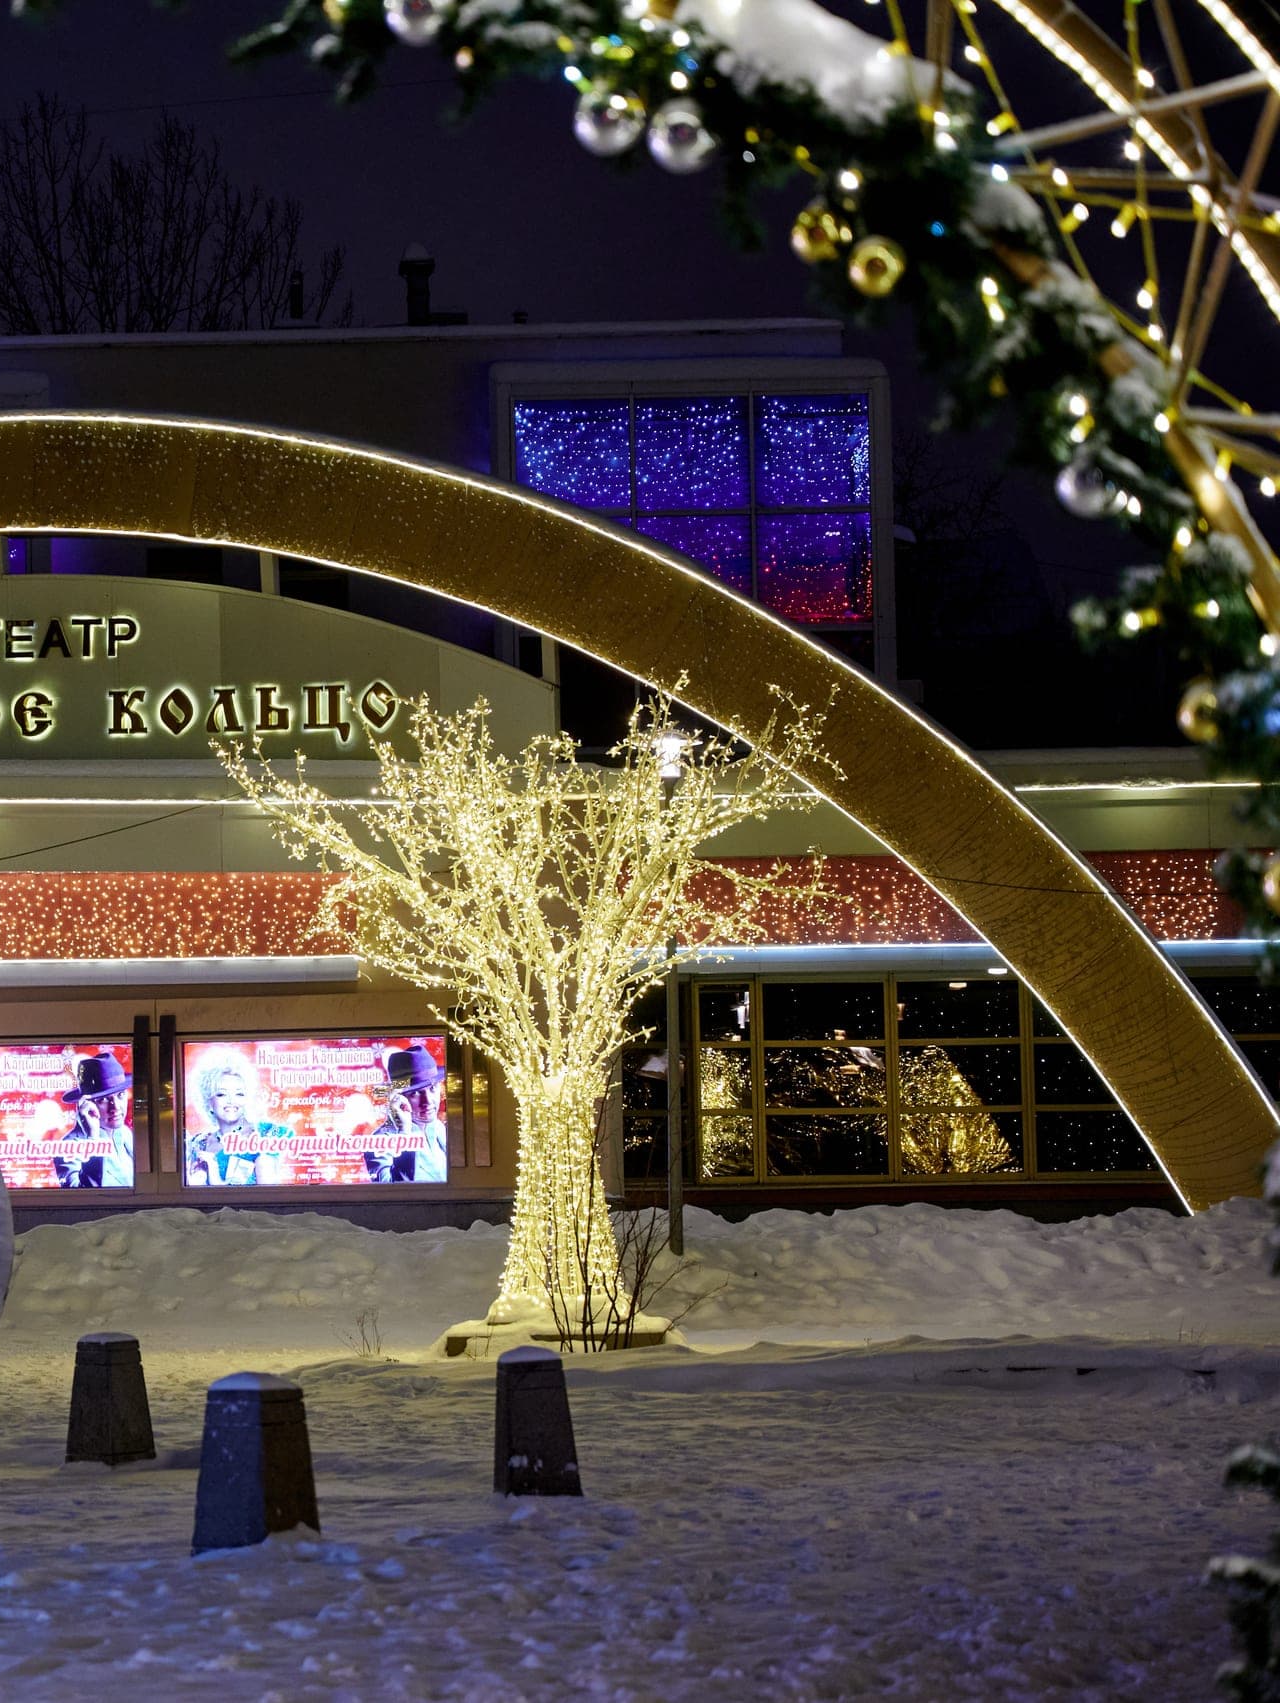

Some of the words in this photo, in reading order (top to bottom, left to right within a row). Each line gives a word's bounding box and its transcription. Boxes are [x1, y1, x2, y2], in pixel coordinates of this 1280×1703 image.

[107, 680, 401, 744] КОЛЬЦО
[32, 1140, 112, 1159] концерт
[224, 1135, 336, 1157] Новогодний
[339, 1135, 425, 1156] концерт
